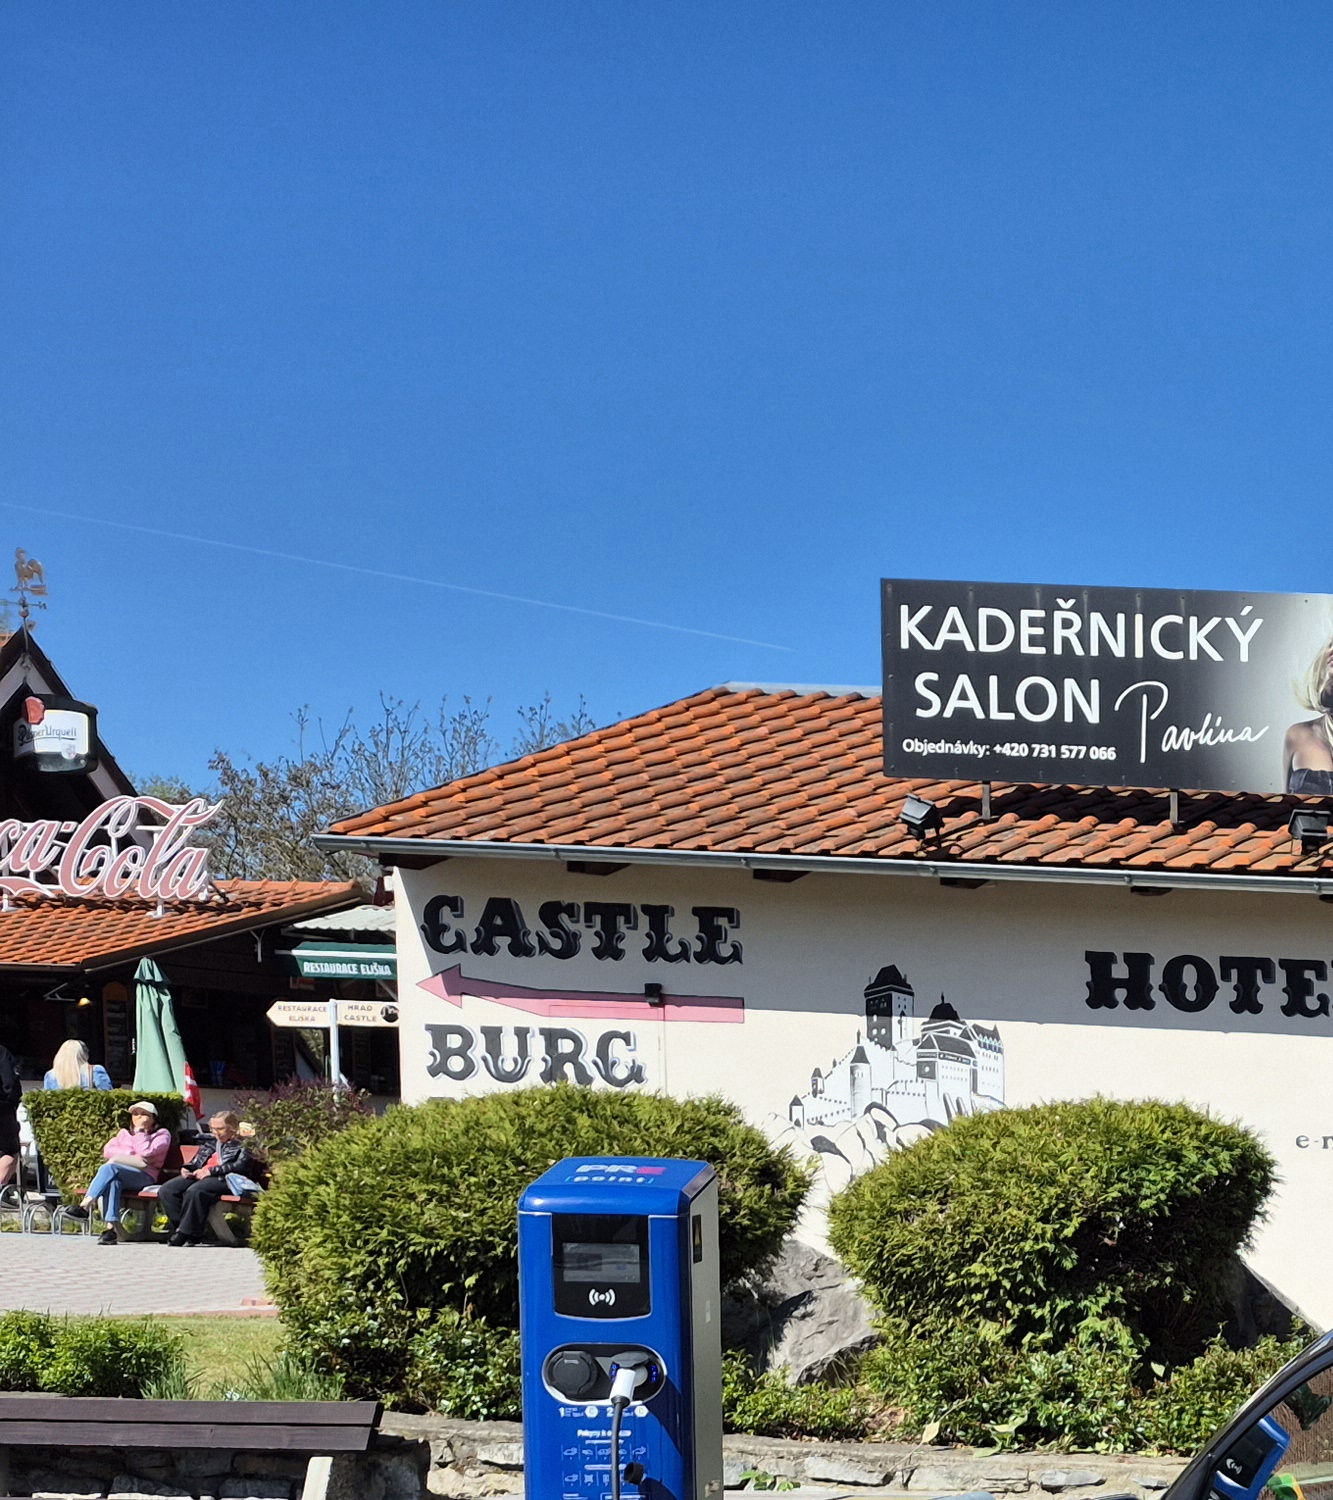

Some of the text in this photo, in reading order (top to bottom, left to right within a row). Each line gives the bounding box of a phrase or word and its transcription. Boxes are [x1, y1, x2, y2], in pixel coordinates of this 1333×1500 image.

[900, 599, 1263, 662] KADEŘNICKÝ
[914, 672, 1101, 724] SALON
[46, 725, 77, 740] Urquell
[902, 738, 1116, 760] Objednávky: +420 731 577 066
[421, 895, 744, 965] CASTLE
[304, 962, 392, 975] RESTAURACE ELIŠKA
[278, 1004, 327, 1013] RESTAURACE
[344, 1014, 377, 1022] CASTLE
[425, 1024, 648, 1088] BURG
[576, 1165, 667, 1175] PRE
